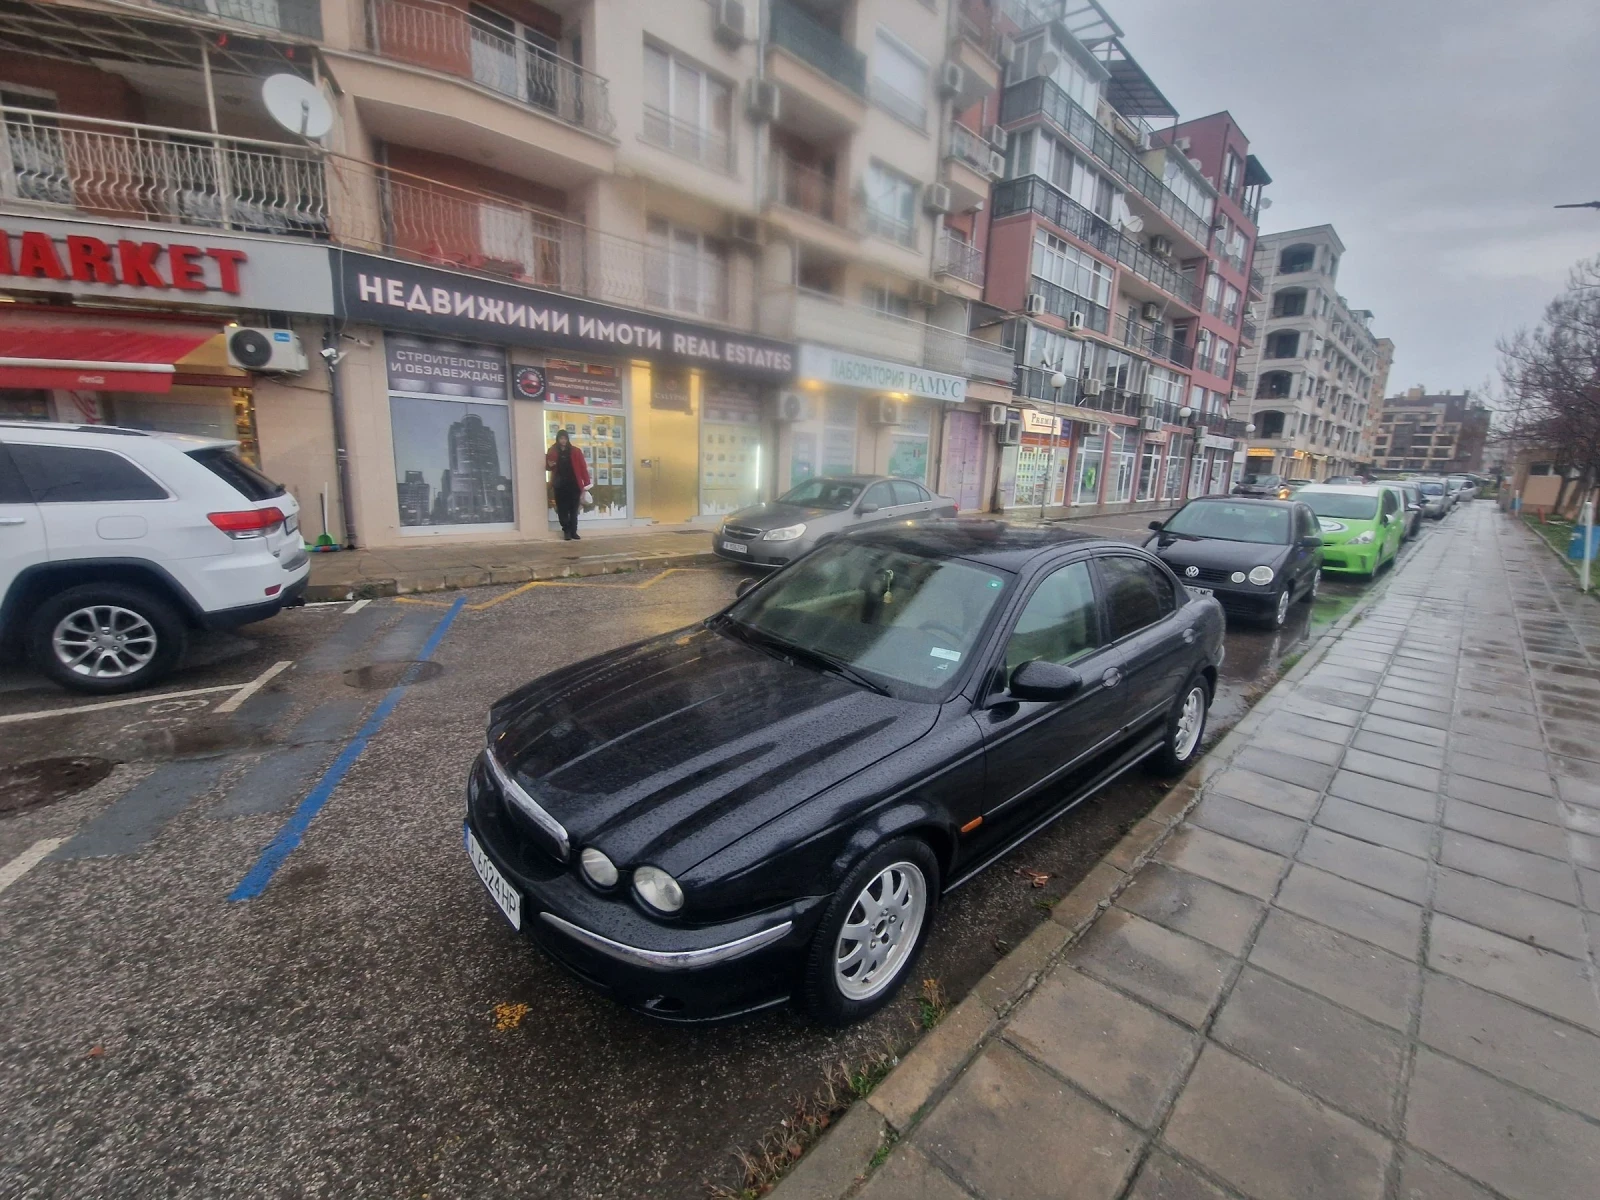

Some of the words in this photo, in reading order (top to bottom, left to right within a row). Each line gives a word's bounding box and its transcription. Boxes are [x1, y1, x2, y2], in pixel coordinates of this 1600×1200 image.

[358, 273, 569, 335] НЕДВИЖИМИ
[579, 315, 662, 350] ИМОТИ
[673, 333, 720, 360] REAL
[725, 343, 792, 371] ESTATES
[396, 350, 499, 371] СТРОИТЕЛСТВО
[391, 362, 402, 372] И
[405, 364, 505, 383] ОБЗАВЕЖДАНЕ
[908, 372, 961, 398] РАМУС
